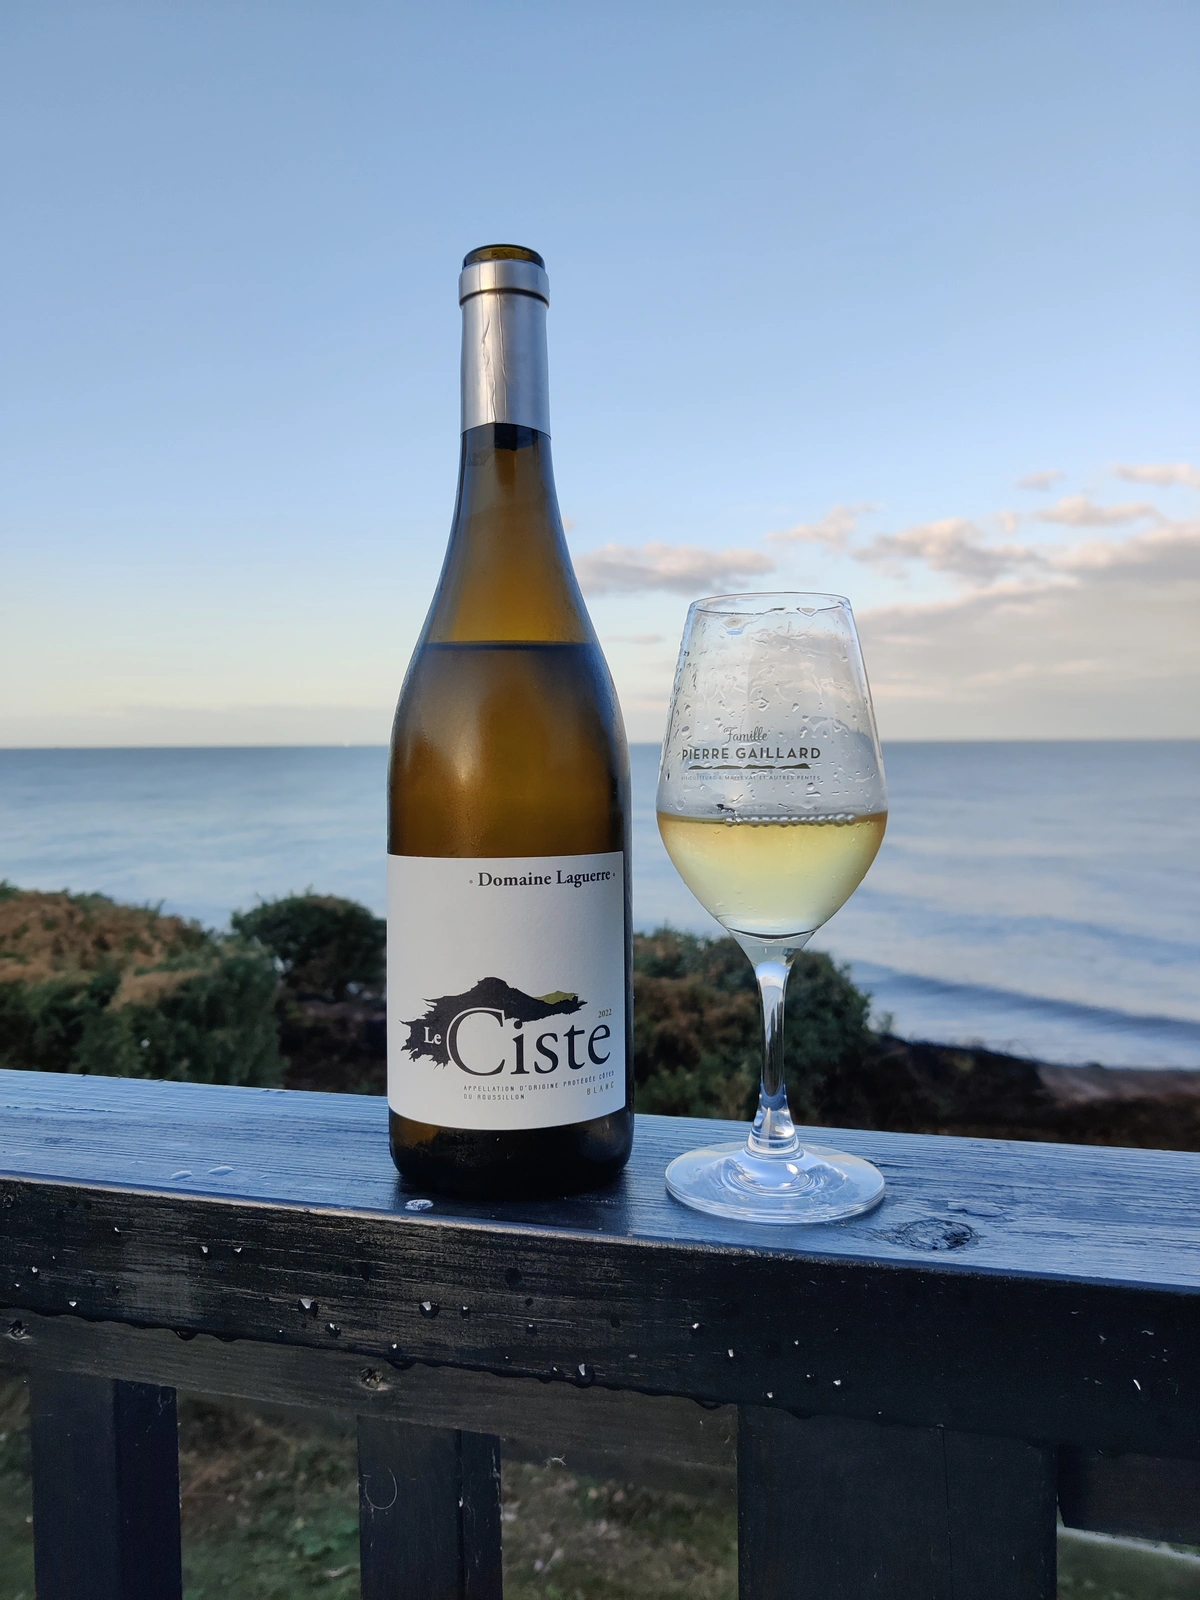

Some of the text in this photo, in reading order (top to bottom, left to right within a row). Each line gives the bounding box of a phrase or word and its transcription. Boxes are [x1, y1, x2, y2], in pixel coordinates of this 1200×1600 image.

[723, 726, 769, 744] Famille
[682, 747, 821, 760] PIERRE GAILLARD
[477, 869, 611, 888] Domaine Laguerre
[597, 1008, 613, 1019] 2022
[423, 1010, 611, 1077] Le Ciste
[519, 1082, 559, 1092] D'ORIGINE
[586, 1080, 615, 1096] BLANC
[477, 1093, 525, 1101] ROUSSILLON
